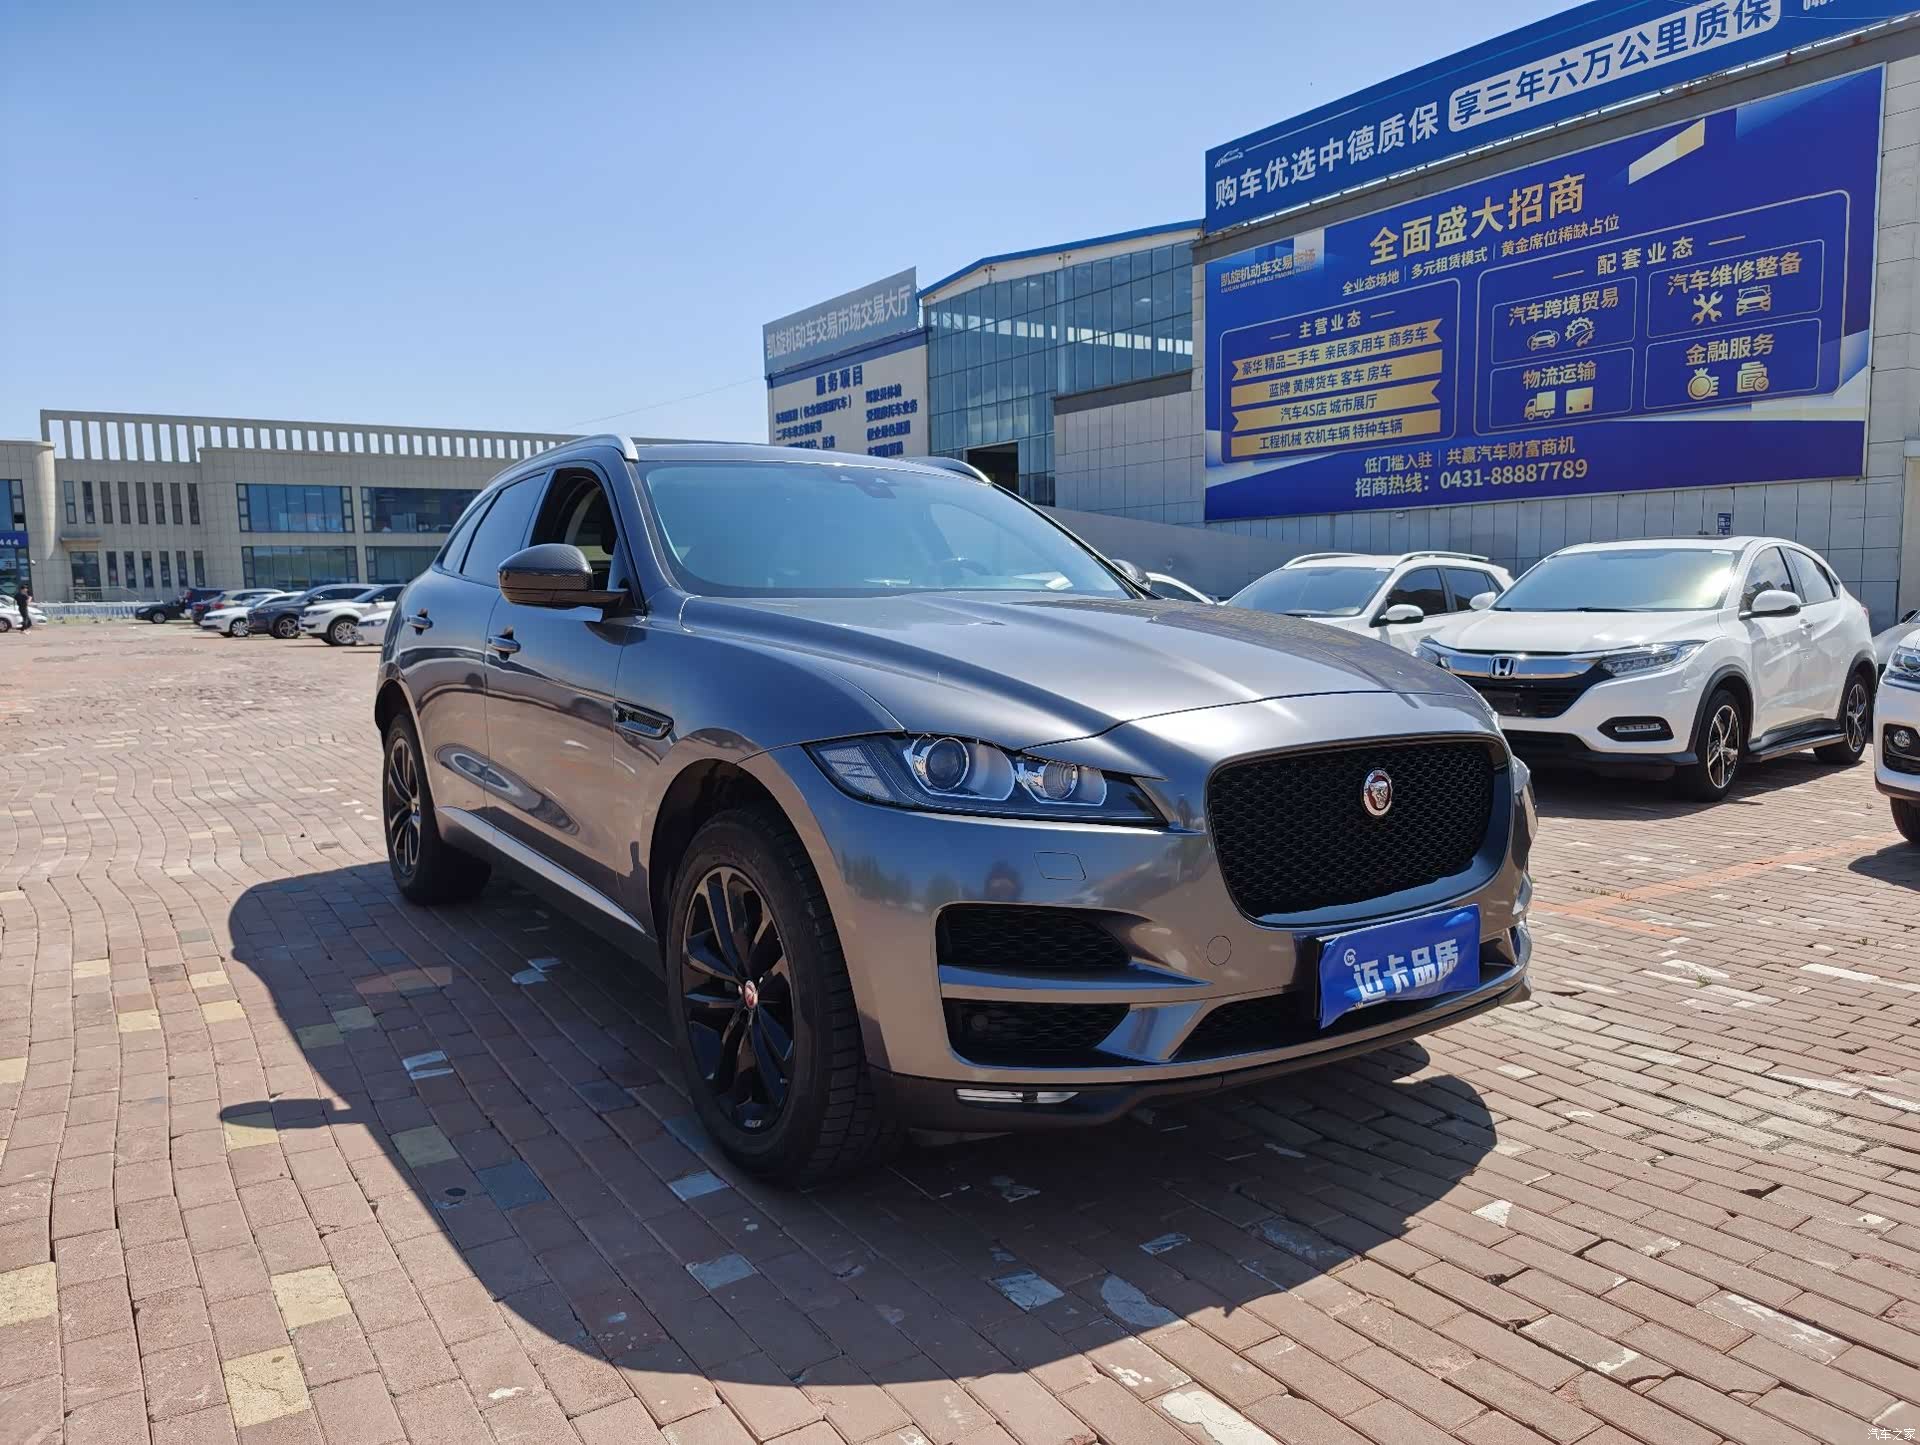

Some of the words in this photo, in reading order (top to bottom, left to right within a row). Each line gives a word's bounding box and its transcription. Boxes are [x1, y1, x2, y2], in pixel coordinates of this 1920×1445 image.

[1215, 101, 1439, 211] 购车优选中德质保
[1454, 0, 1772, 126] 享三年六万公里质保
[1369, 172, 1585, 266] 全面盛大招商
[1342, 270, 1400, 296] 全业态场地
[1411, 247, 1488, 280] 多元租赁模式
[1501, 213, 1620, 258] 黄金席位稀缺占位
[1597, 236, 1694, 276] 配套业态
[1667, 251, 1803, 295] 汽车维修整备
[767, 284, 911, 361] 凯旋机动车交易市场交易大厅
[1298, 310, 1362, 339] 主营业态
[1508, 286, 1620, 327] 汽车跨境贸易
[1241, 358, 1262, 376] 豪华
[1264, 348, 1320, 373] 精品二手车
[1324, 335, 1386, 361] 亲民家用车
[1388, 327, 1429, 348] 商务车
[1685, 333, 1775, 366] 金融服务
[1268, 382, 1291, 399] 蓝牌
[1292, 372, 1339, 395] 黄牌货车
[1341, 368, 1365, 386] 客车
[1367, 363, 1393, 382] 房车
[1522, 360, 1597, 390] 物流运输
[1280, 403, 1327, 423] 汽车4S店
[1329, 394, 1378, 416] 城市展厅
[1259, 432, 1302, 451] 工程机械
[1303, 424, 1351, 446] 农机车辆
[1352, 418, 1404, 439] 特种车辆
[1364, 452, 1433, 475] 低门槛入驻
[1446, 436, 1576, 464] 共赢汽车财富商机
[1353, 938, 1459, 1002] 迈卡品质
